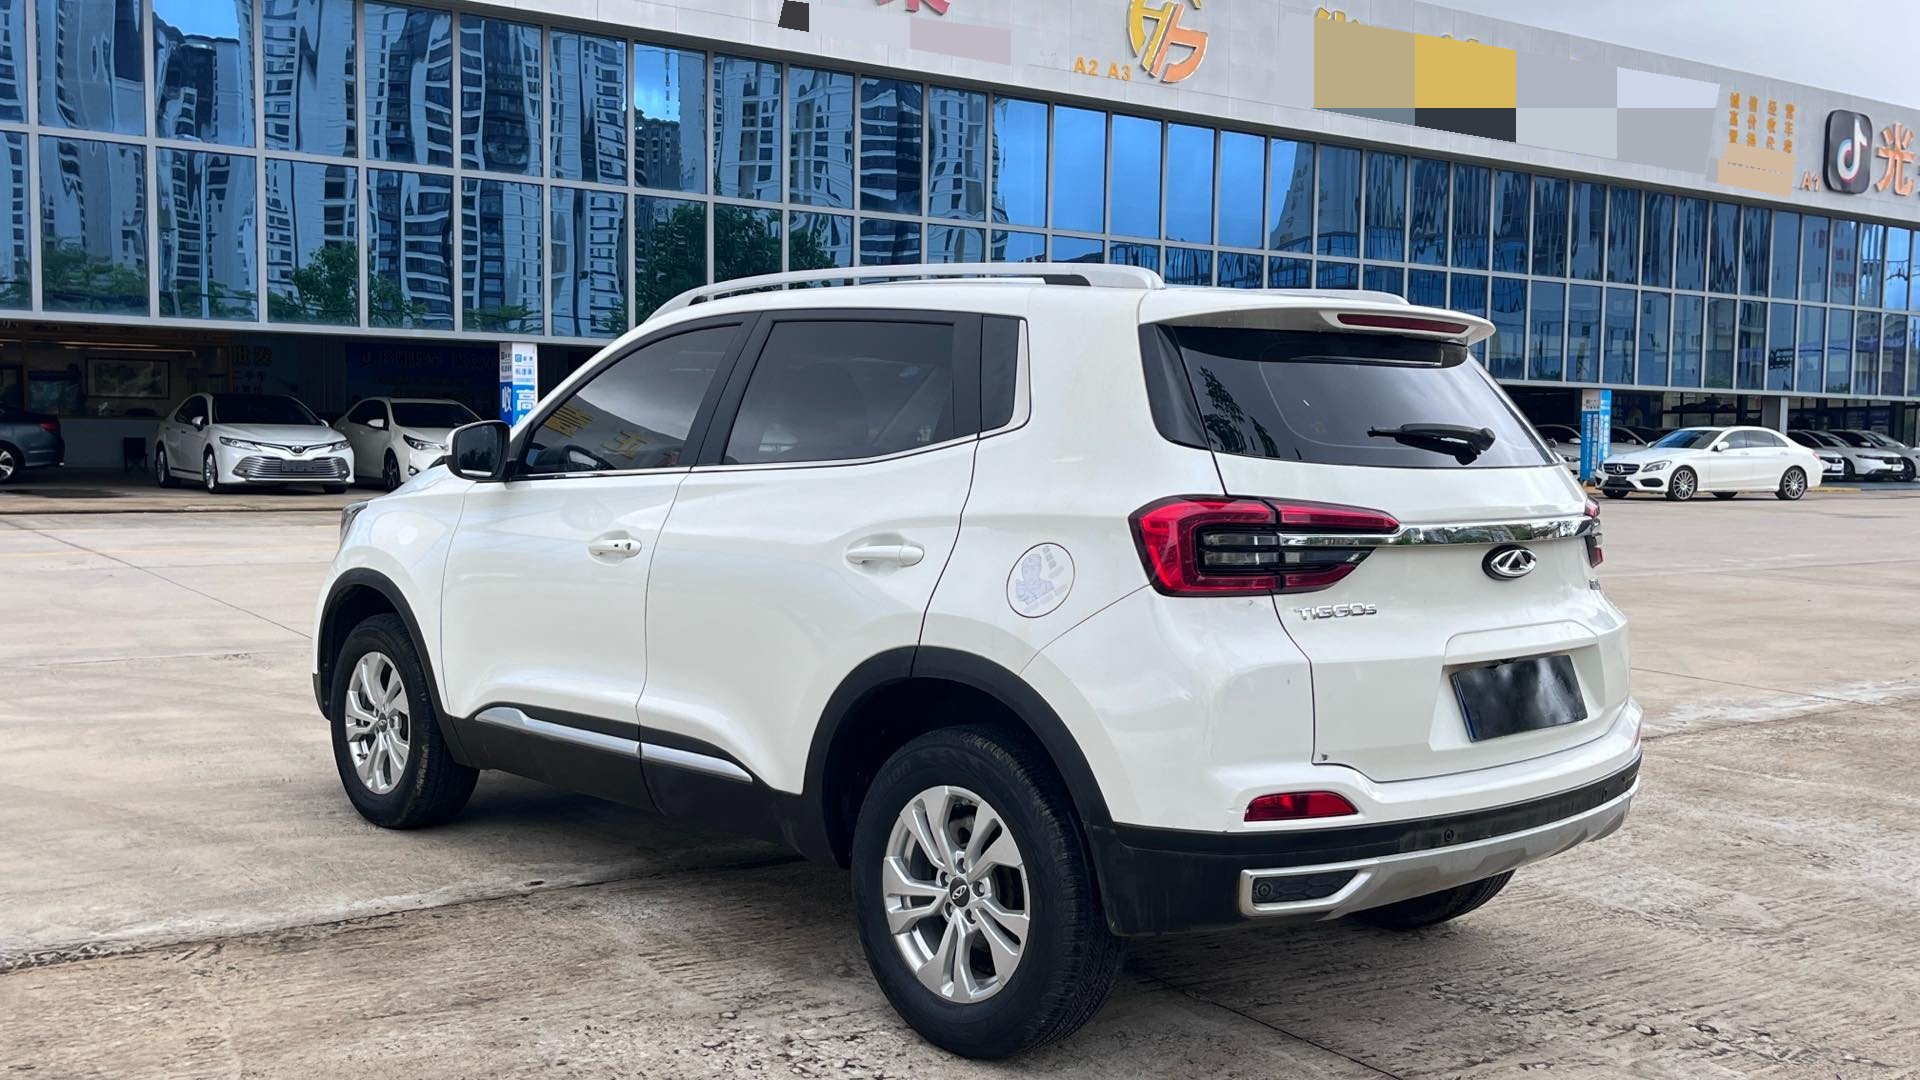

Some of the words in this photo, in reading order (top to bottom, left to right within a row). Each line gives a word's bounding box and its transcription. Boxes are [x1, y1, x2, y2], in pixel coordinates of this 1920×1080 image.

[1074, 55, 1098, 76] A2
[1108, 61, 1132, 81] A3
[1875, 122, 1914, 196] 光
[1802, 171, 1821, 191] A1
